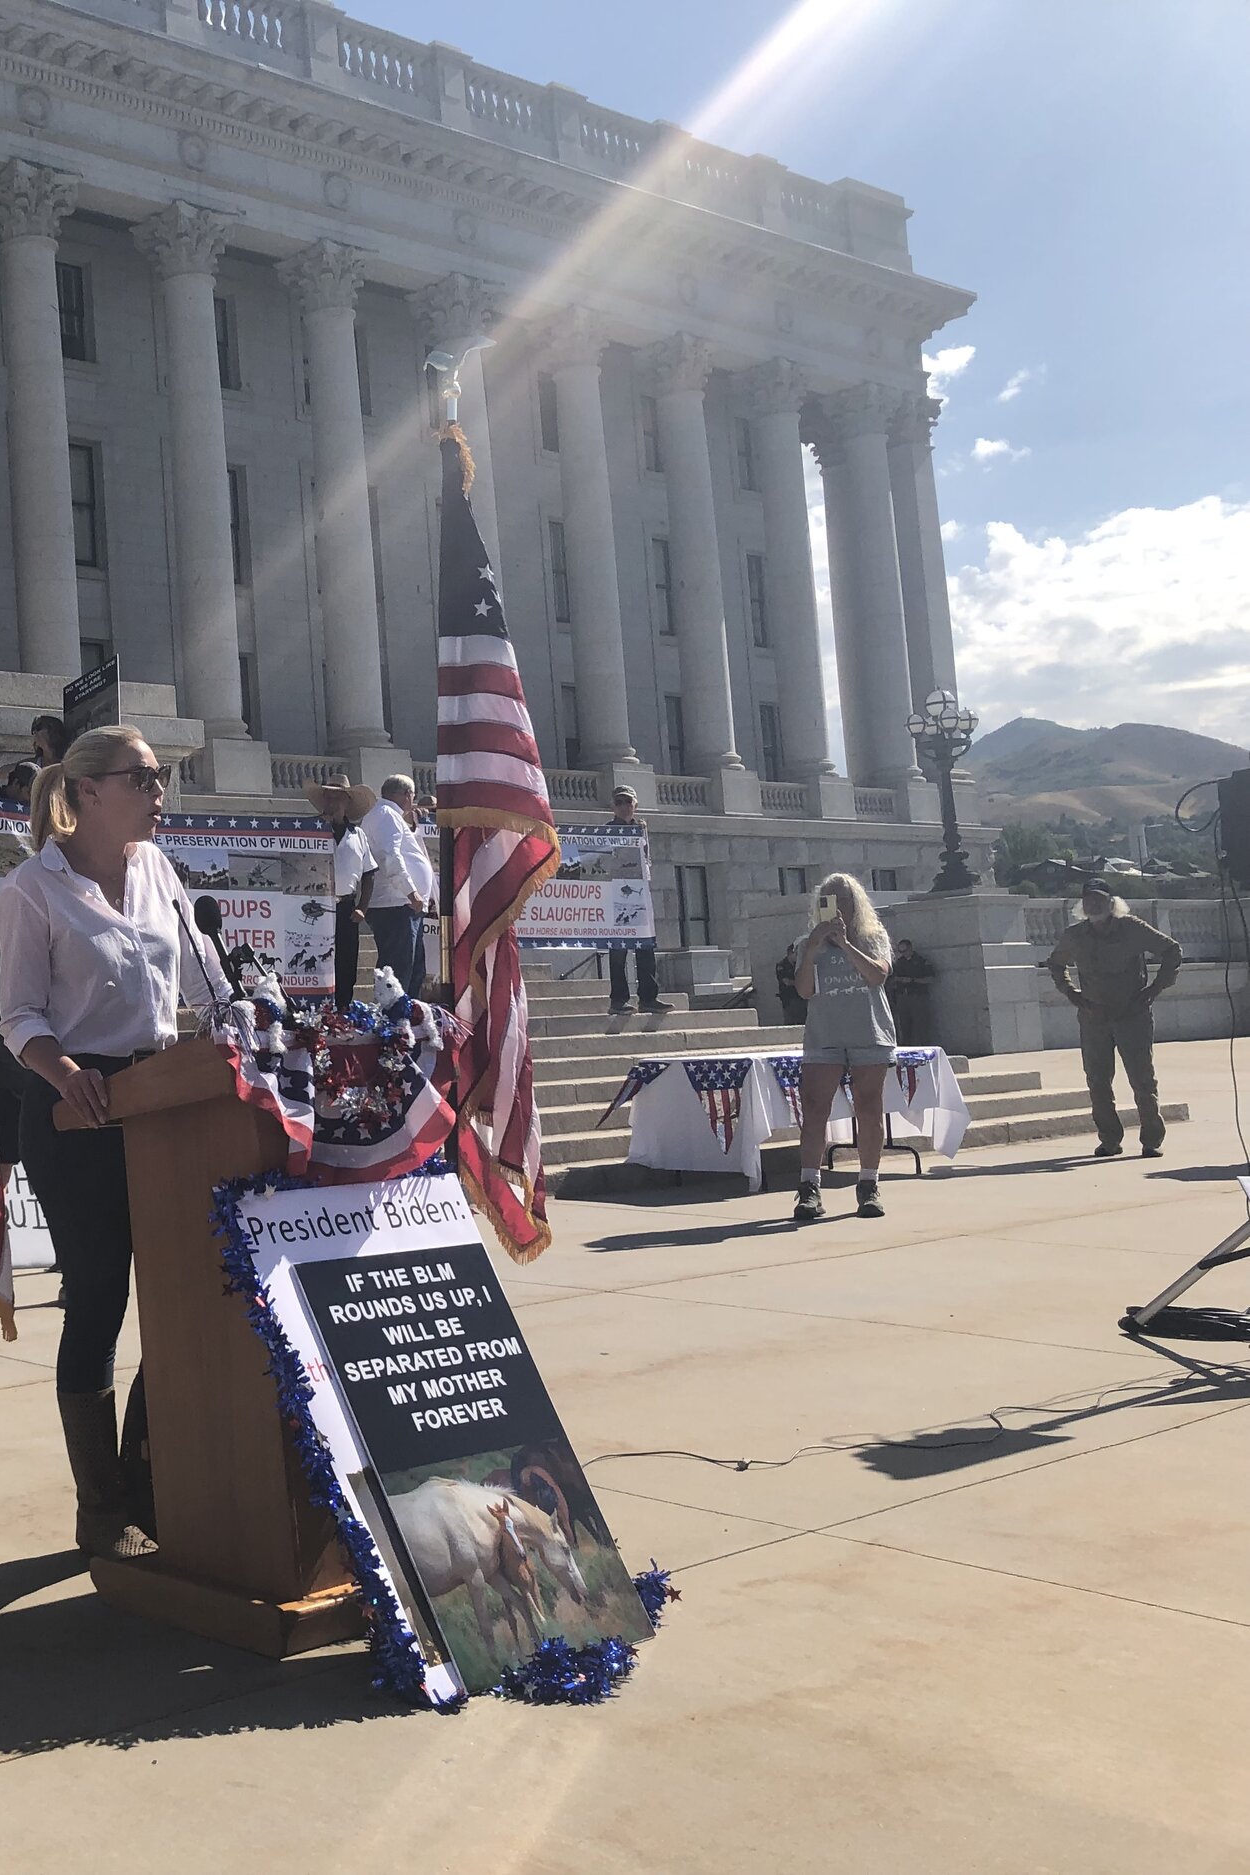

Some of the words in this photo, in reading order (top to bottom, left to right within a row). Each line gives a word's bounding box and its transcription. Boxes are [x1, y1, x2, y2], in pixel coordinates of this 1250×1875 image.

[90, 675, 102, 685] ARE
[165, 835, 257, 848] PRESERVATION
[261, 837, 276, 849] OF
[279, 837, 328, 850] WILDLIFE
[597, 837, 607, 845] OF
[609, 837, 640, 847] WILDLIFE
[535, 883, 602, 900] ROUNDUPS
[530, 906, 606, 922] SLAUGHTER
[517, 927, 535, 935] WILD
[536, 927, 558, 936] HORSE
[559, 927, 572, 936] AND
[573, 927, 598, 936] BURRO
[599, 928, 637, 937] ROUNDUPS
[246, 1204, 380, 1246] President
[382, 1197, 466, 1229] Biden:
[345, 1273, 365, 1293] IF
[368, 1267, 411, 1290] THE
[411, 1262, 456, 1286] BLM
[328, 1297, 417, 1325] ROUNDS
[417, 1291, 447, 1311] US
[448, 1287, 483, 1308] UP,
[482, 1285, 492, 1303] I
[381, 1321, 435, 1346] WILL
[435, 1316, 466, 1339] BE
[344, 1345, 463, 1382] SEPARATED
[464, 1336, 523, 1363] FROM
[386, 1382, 417, 1406] MY
[421, 1368, 508, 1400] MOTHER
[411, 1397, 508, 1432] FOREVER
